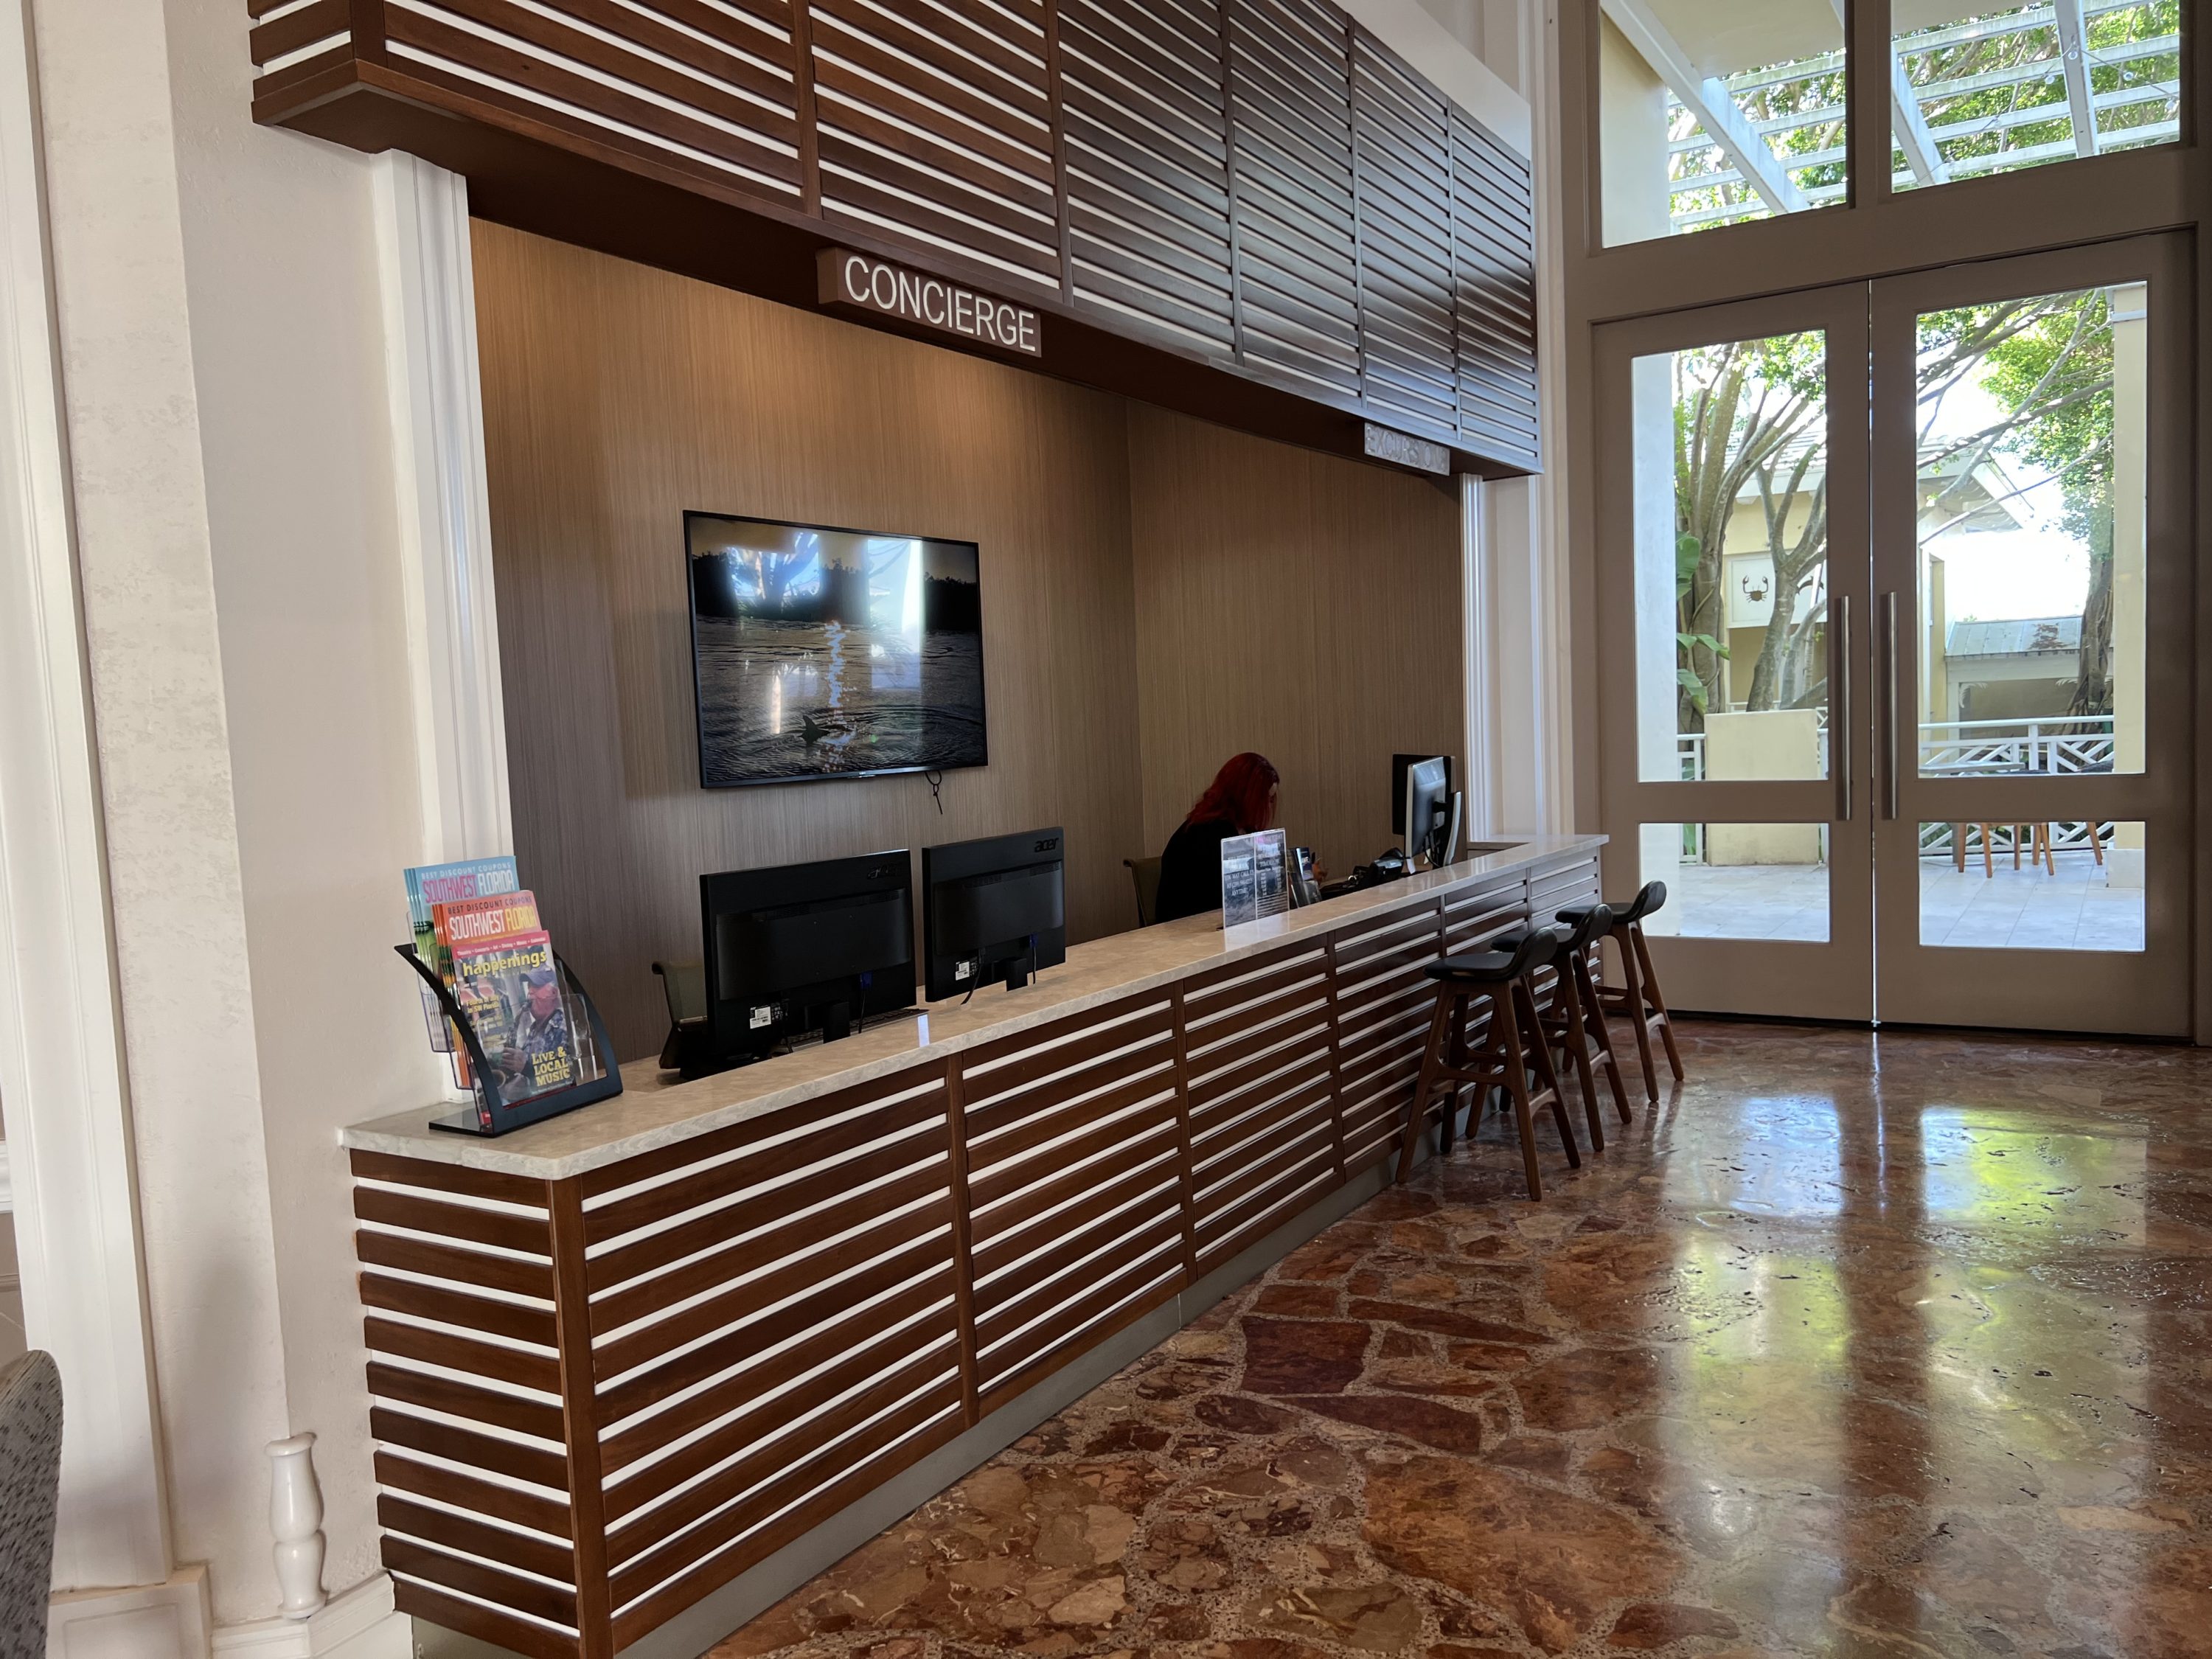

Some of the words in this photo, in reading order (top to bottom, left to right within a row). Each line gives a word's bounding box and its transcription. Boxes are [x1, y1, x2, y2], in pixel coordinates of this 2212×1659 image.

[845, 256, 1035, 351] CONCIERGE
[1034, 838, 1060, 852] acer
[421, 872, 437, 880] BEST
[440, 866, 476, 877] DISCOUNT
[478, 862, 511, 872] COUPONS
[422, 874, 478, 903] SOUTHWEST
[477, 869, 515, 896] FLORIDA
[448, 905, 464, 914] BEST
[467, 900, 503, 911] DISCOUNT
[505, 897, 532, 905] COUPONS
[449, 909, 505, 941] SOUTHWEST
[504, 906, 538, 932] FLORIDA
[462, 951, 547, 977] happenings
[532, 1051, 555, 1065] LIVE
[557, 1046, 567, 1058] &
[533, 1058, 568, 1076] LOCAL
[536, 1068, 571, 1087] MUSIC
